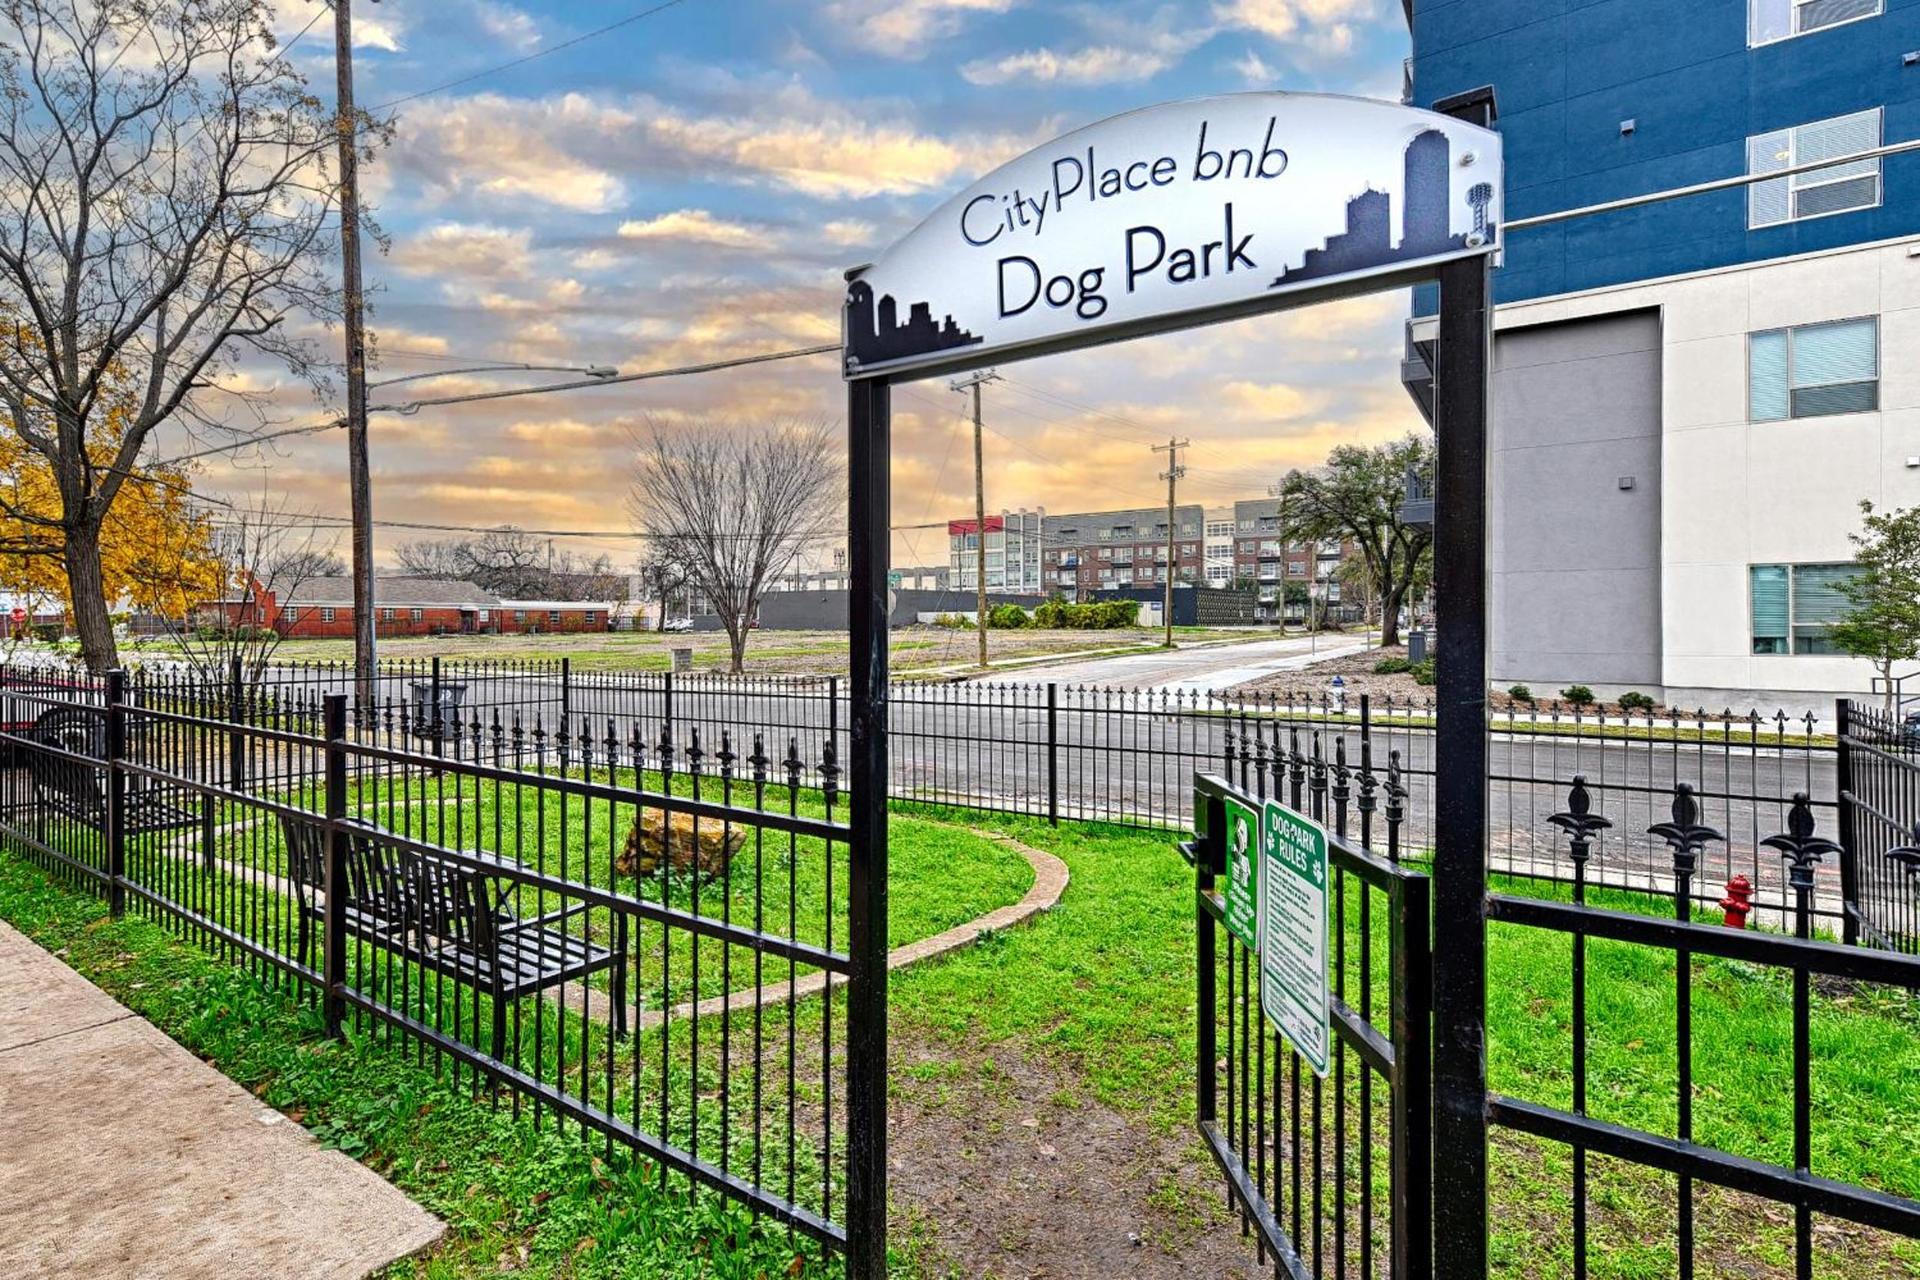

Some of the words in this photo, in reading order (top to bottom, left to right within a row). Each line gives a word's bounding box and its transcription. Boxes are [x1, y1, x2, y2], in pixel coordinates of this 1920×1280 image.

[1193, 116, 1289, 181] bnb
[997, 256, 1107, 320] Dog
[1125, 202, 1257, 294] Park
[1272, 812, 1289, 839] DOG
[1290, 823, 1316, 855] PARK
[1279, 838, 1307, 871] RULES
